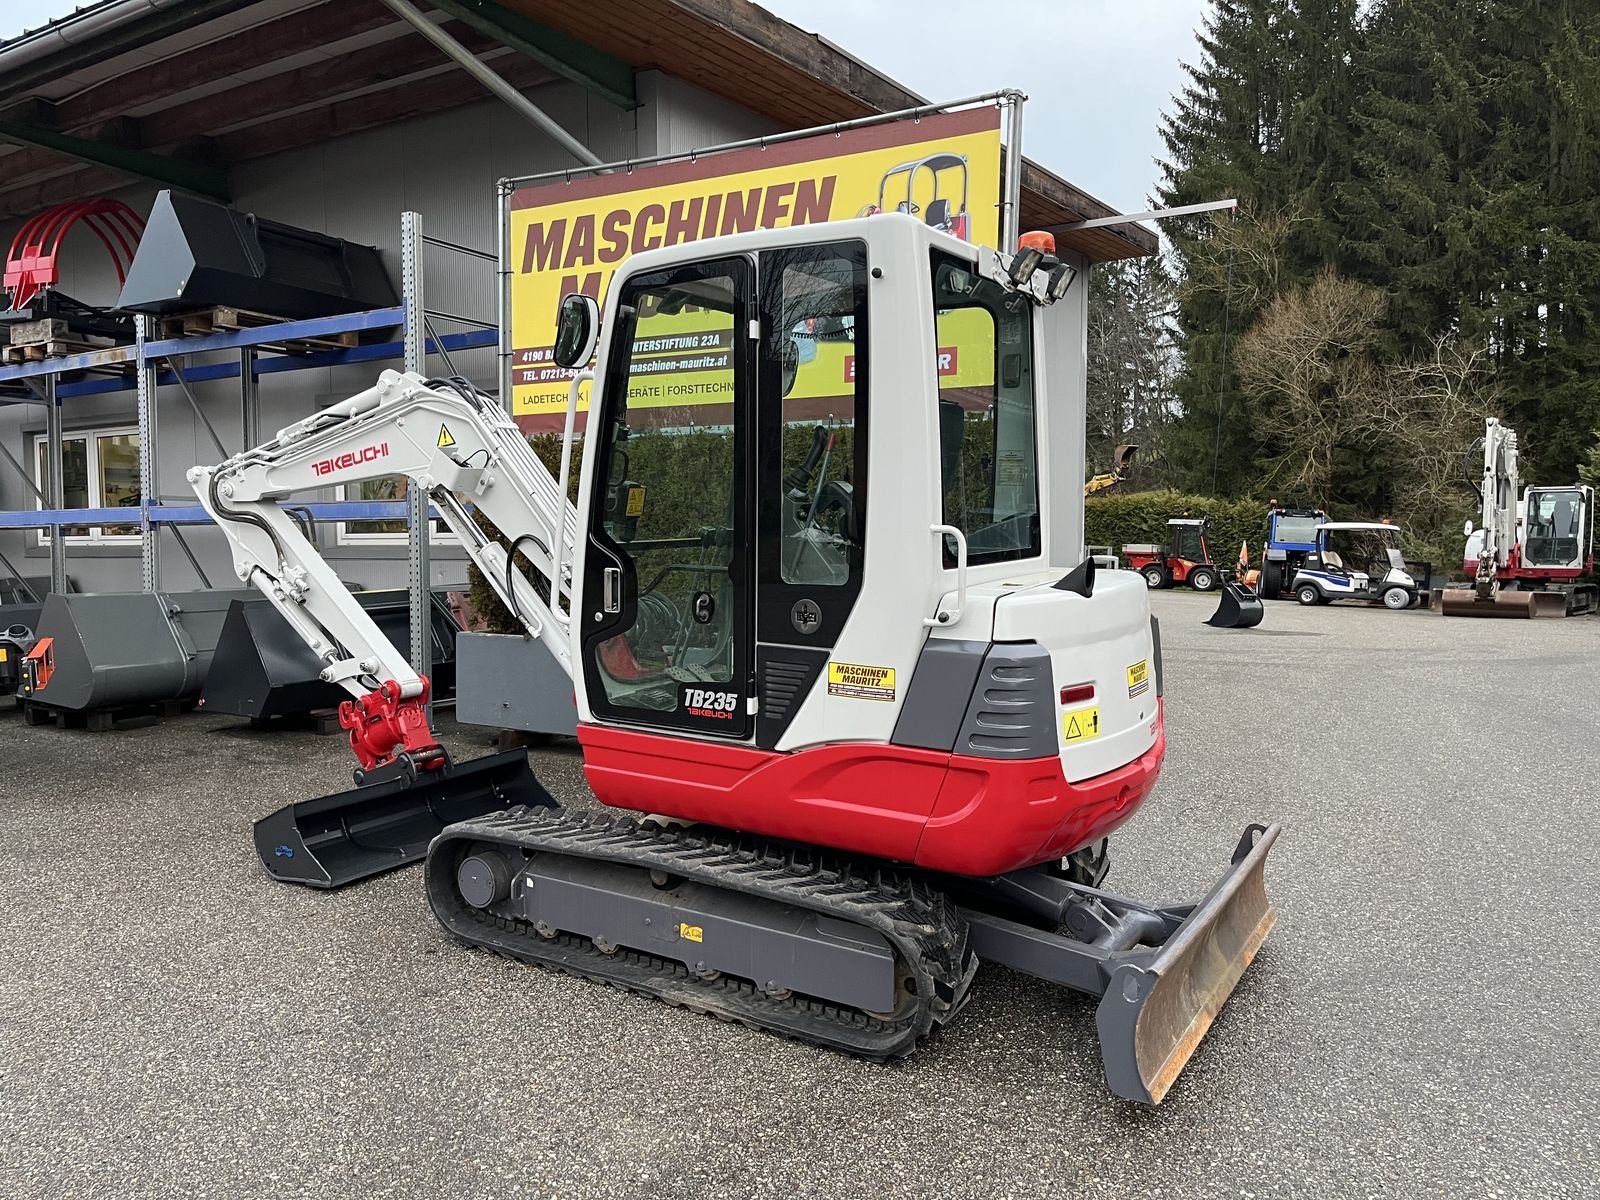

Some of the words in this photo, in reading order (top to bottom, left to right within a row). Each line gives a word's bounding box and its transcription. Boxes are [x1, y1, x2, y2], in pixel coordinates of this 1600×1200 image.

[521, 175, 837, 275] MASCHINEN
[632, 336, 699, 353] NTERSTIFTUNG
[701, 334, 720, 347] 23A
[522, 351, 543, 362] 4190
[522, 371, 538, 381] TEL.
[523, 392, 584, 405] LADETECHK
[311, 442, 390, 477] TAKEUCHI
[836, 665, 889, 679] MASCHINEN
[841, 675, 882, 687] MAURITZ
[684, 688, 738, 711] TB235
